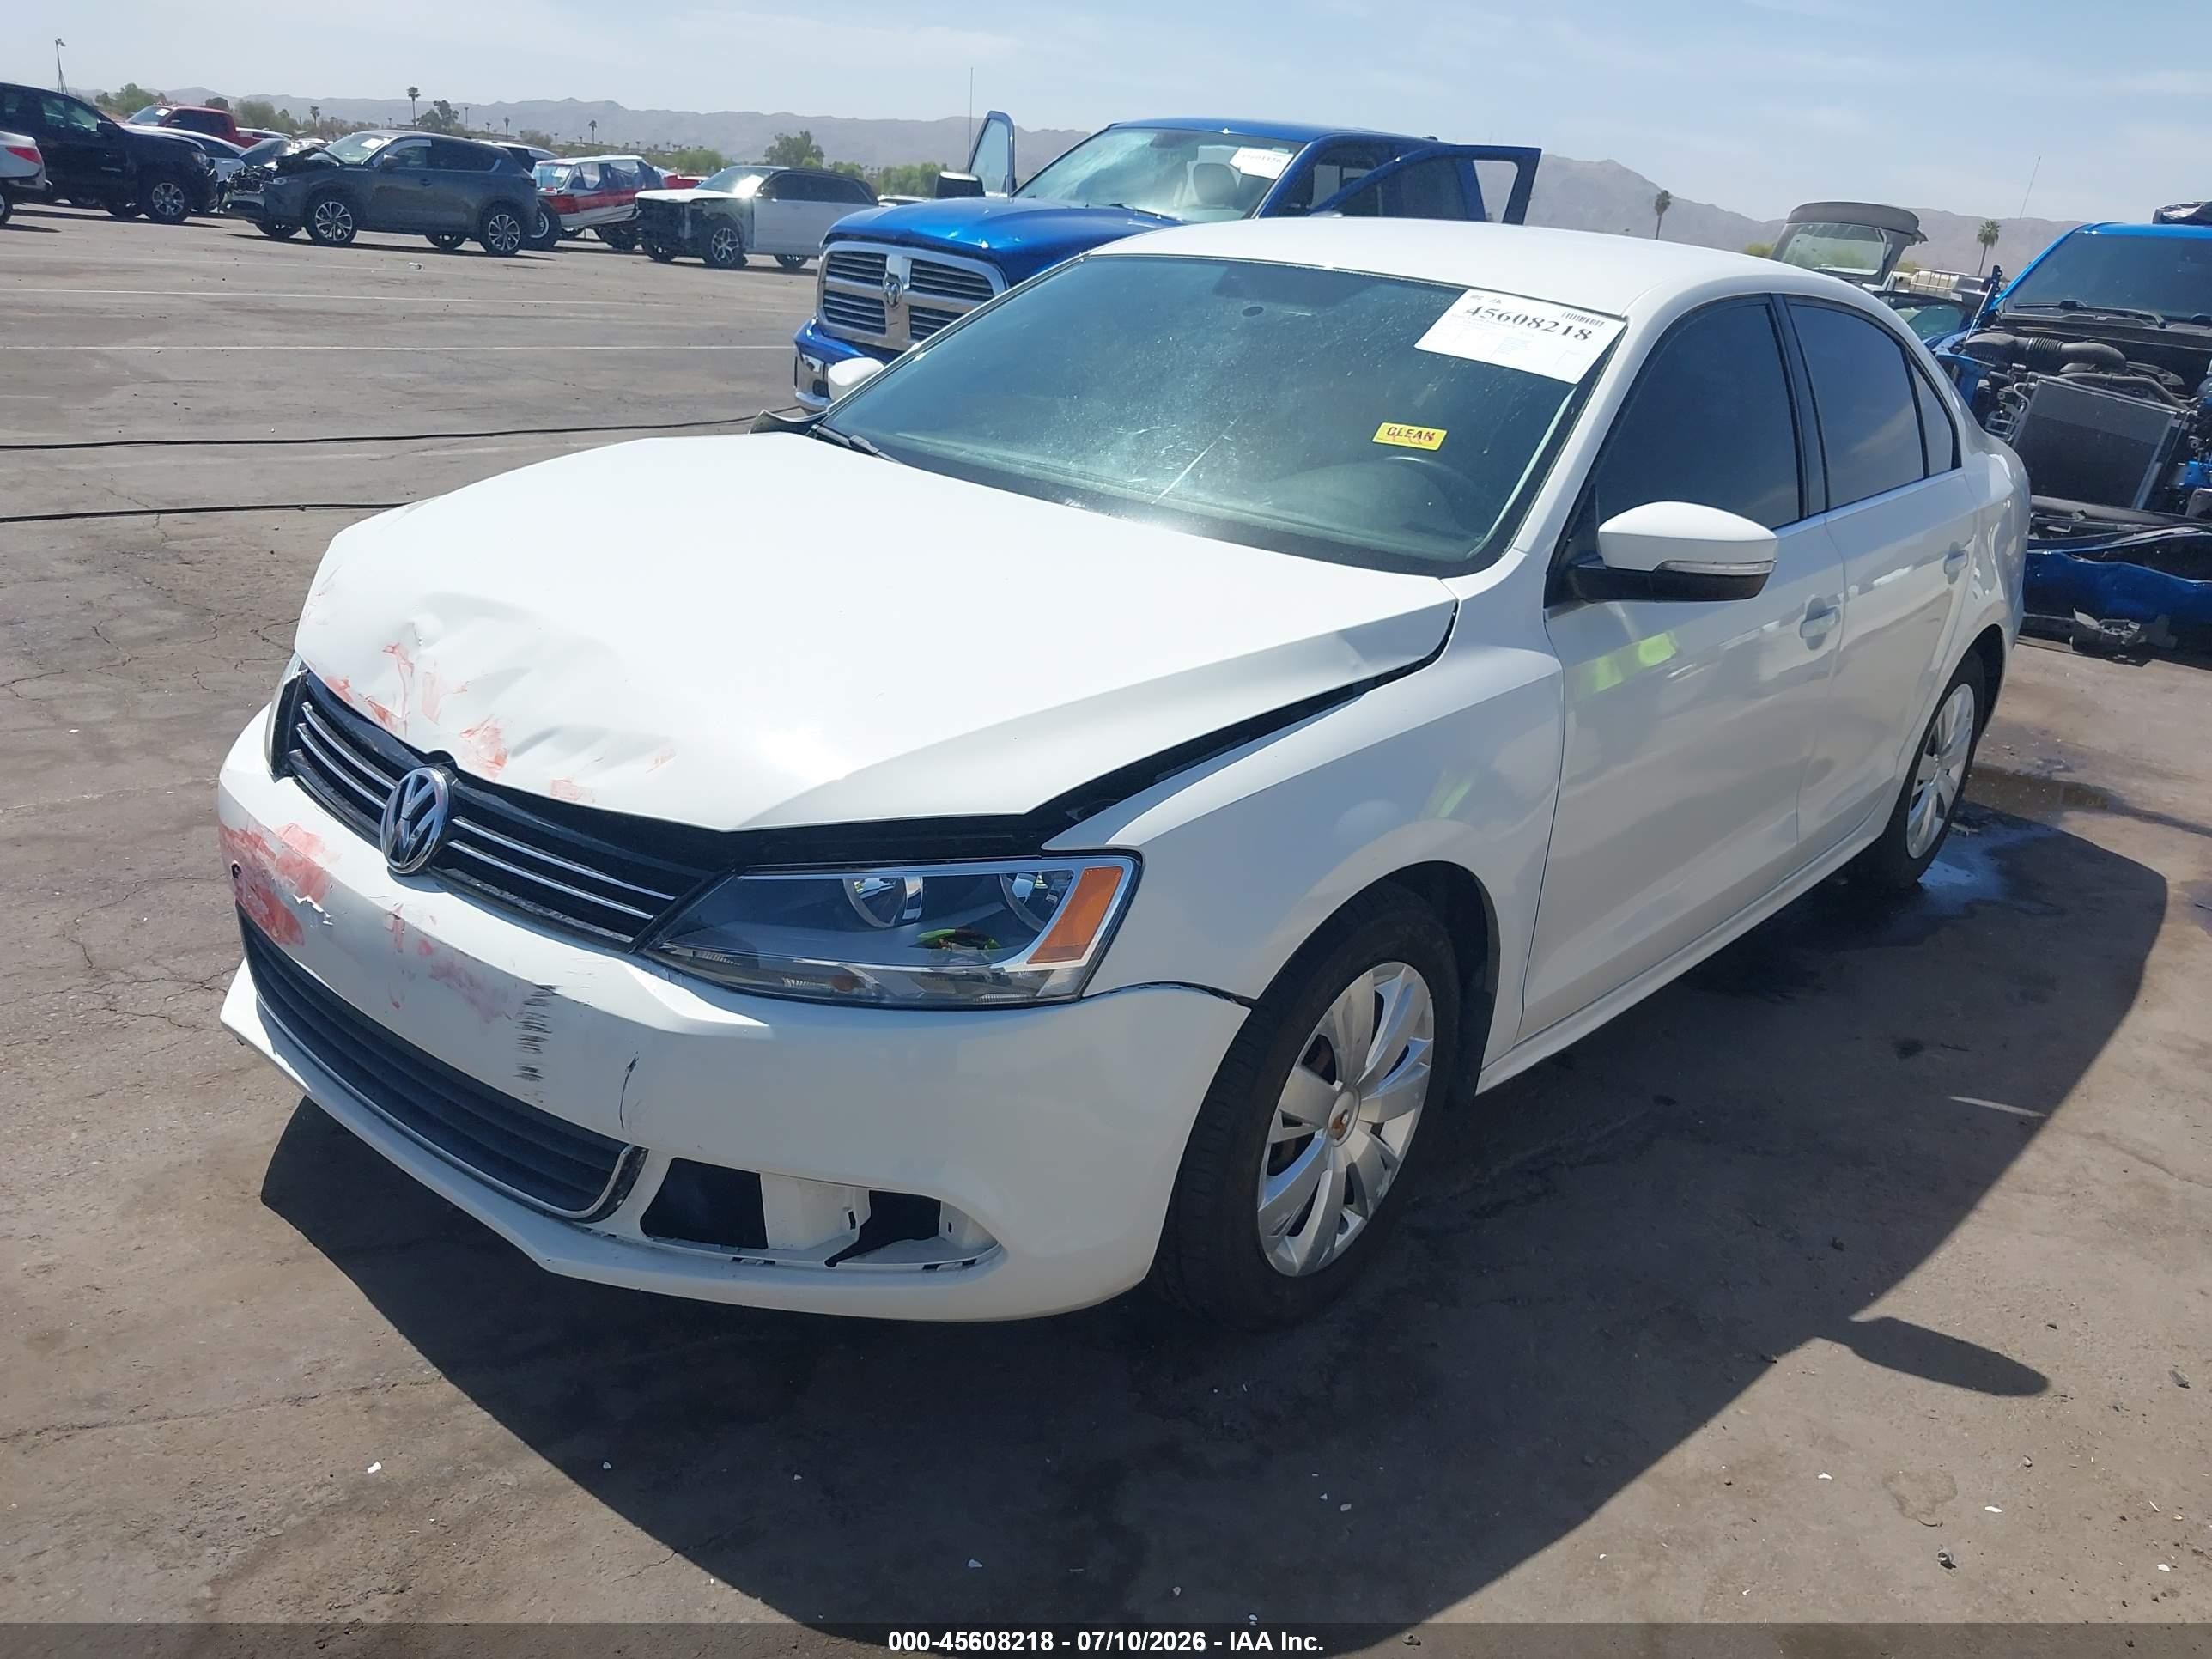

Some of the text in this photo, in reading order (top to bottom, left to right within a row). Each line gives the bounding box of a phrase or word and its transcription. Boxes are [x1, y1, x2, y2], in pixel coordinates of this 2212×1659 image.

[1465, 306, 1593, 341] 45608218
[1386, 426, 1436, 441] CLEAN
[380, 766, 449, 874] VW
